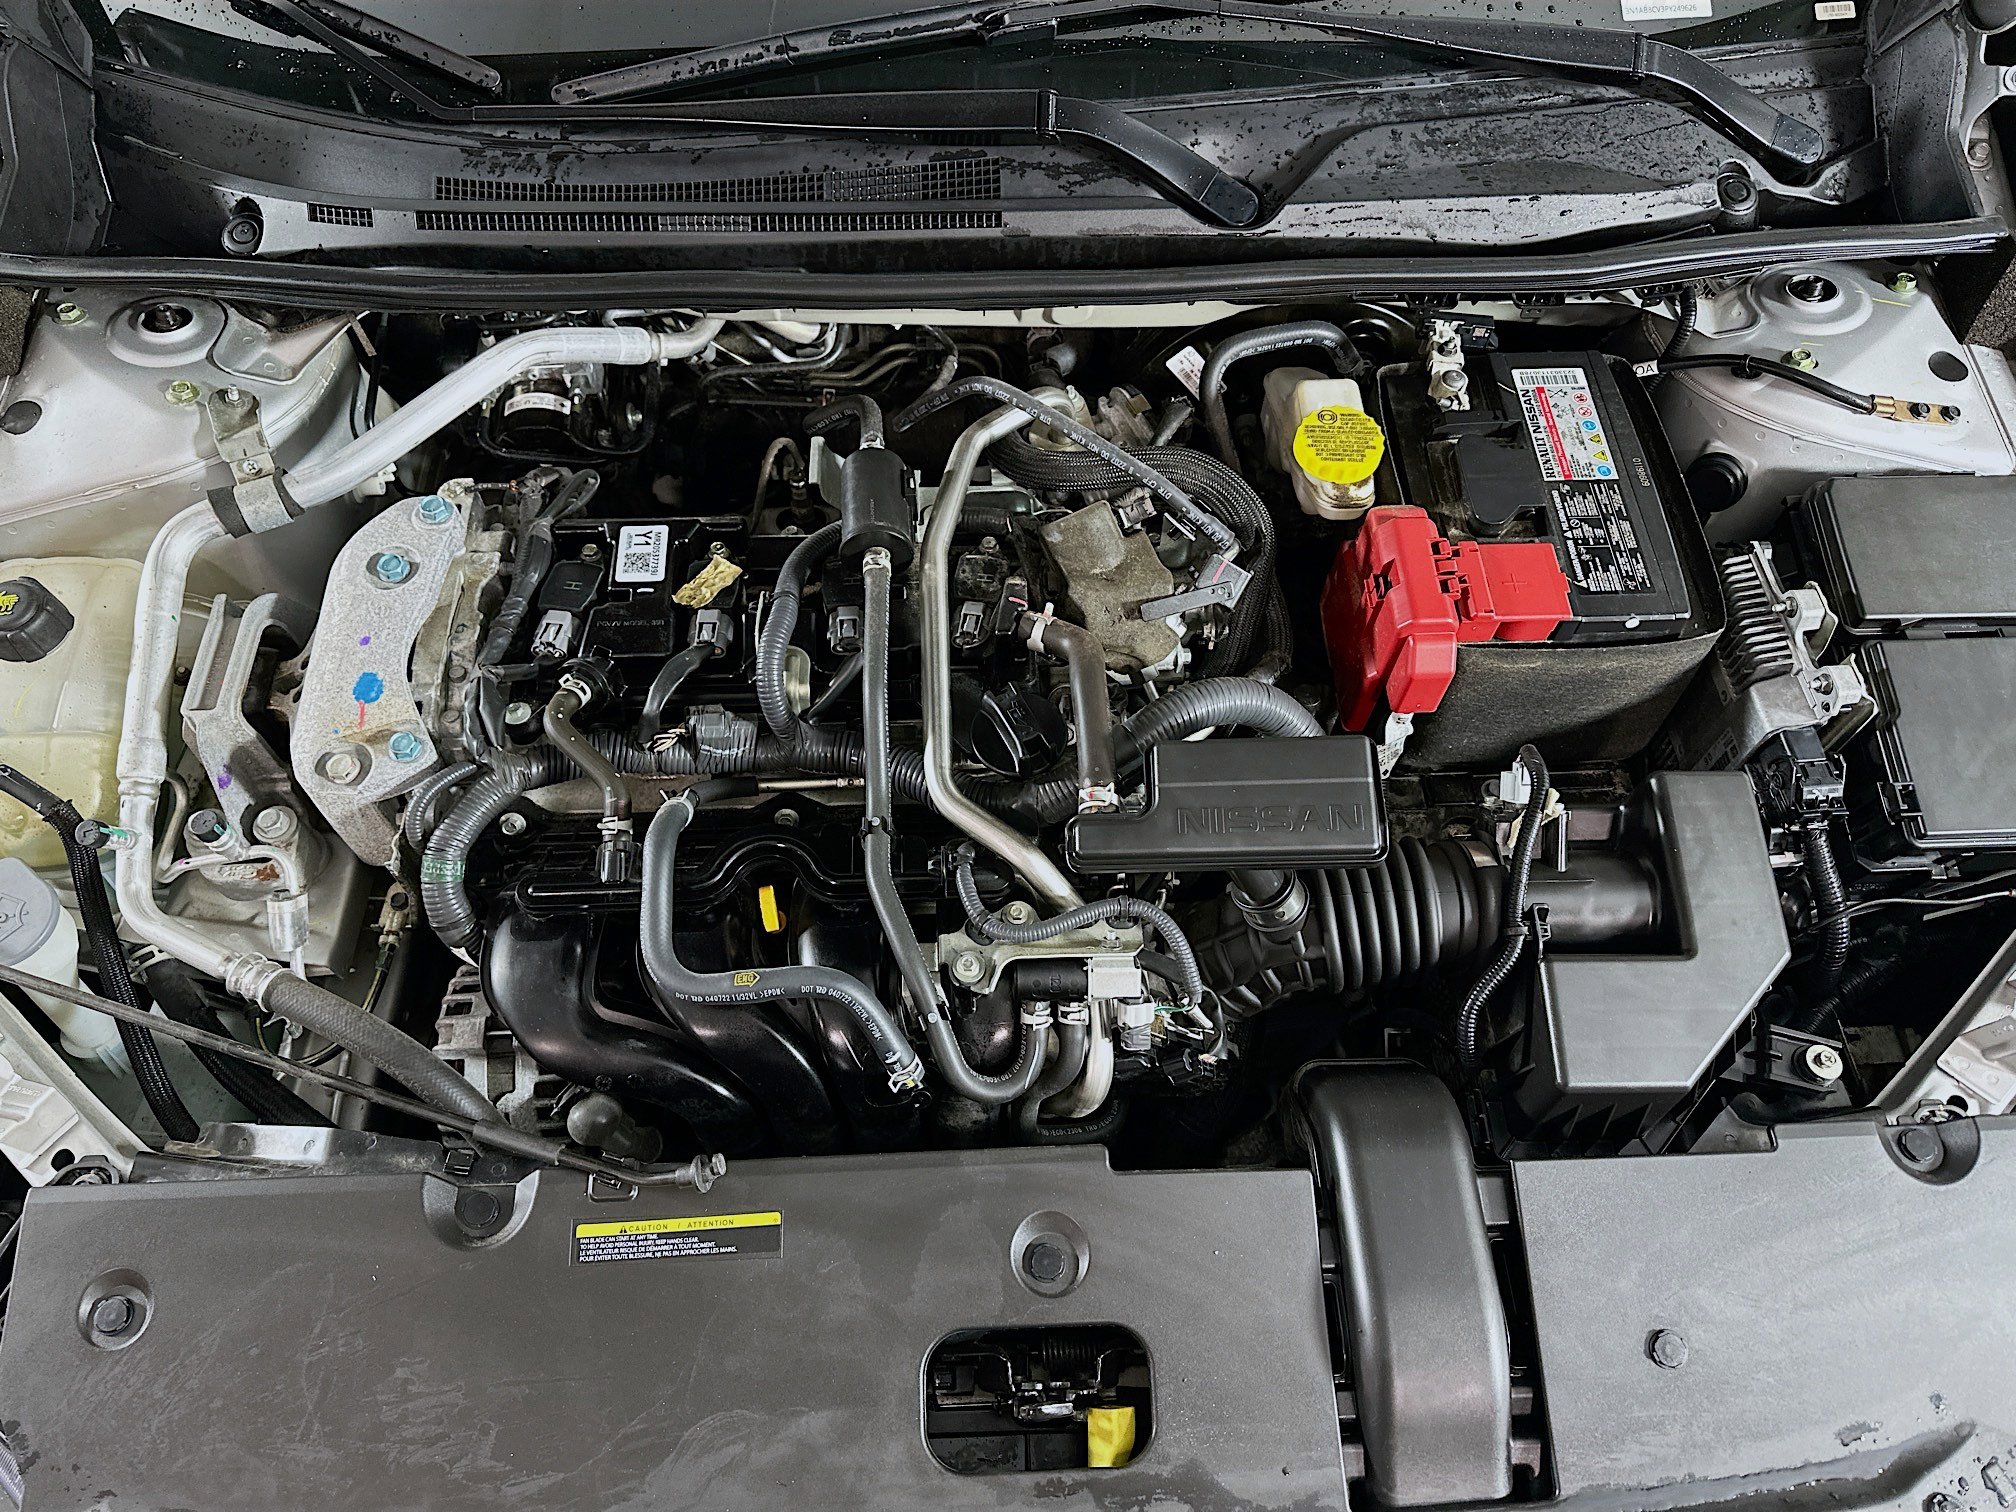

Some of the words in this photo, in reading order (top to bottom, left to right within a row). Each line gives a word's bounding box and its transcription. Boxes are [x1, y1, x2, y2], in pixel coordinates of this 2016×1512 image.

[1519, 388, 1543, 434] NISSAN
[1535, 436, 1557, 479] RENAULT
[633, 530, 653, 546] Y1
[1176, 803, 1366, 836] NISSAN
[675, 991, 689, 1001] DOT
[801, 985, 814, 994] DOT
[828, 988, 852, 1005] 040722
[629, 1223, 669, 1233] CAUTION
[687, 1219, 735, 1229] ATTENTION
[586, 1248, 619, 1256] VENTILATEUR
[619, 1246, 638, 1254] RISQUE
[680, 1248, 711, 1256] APPROCHER
